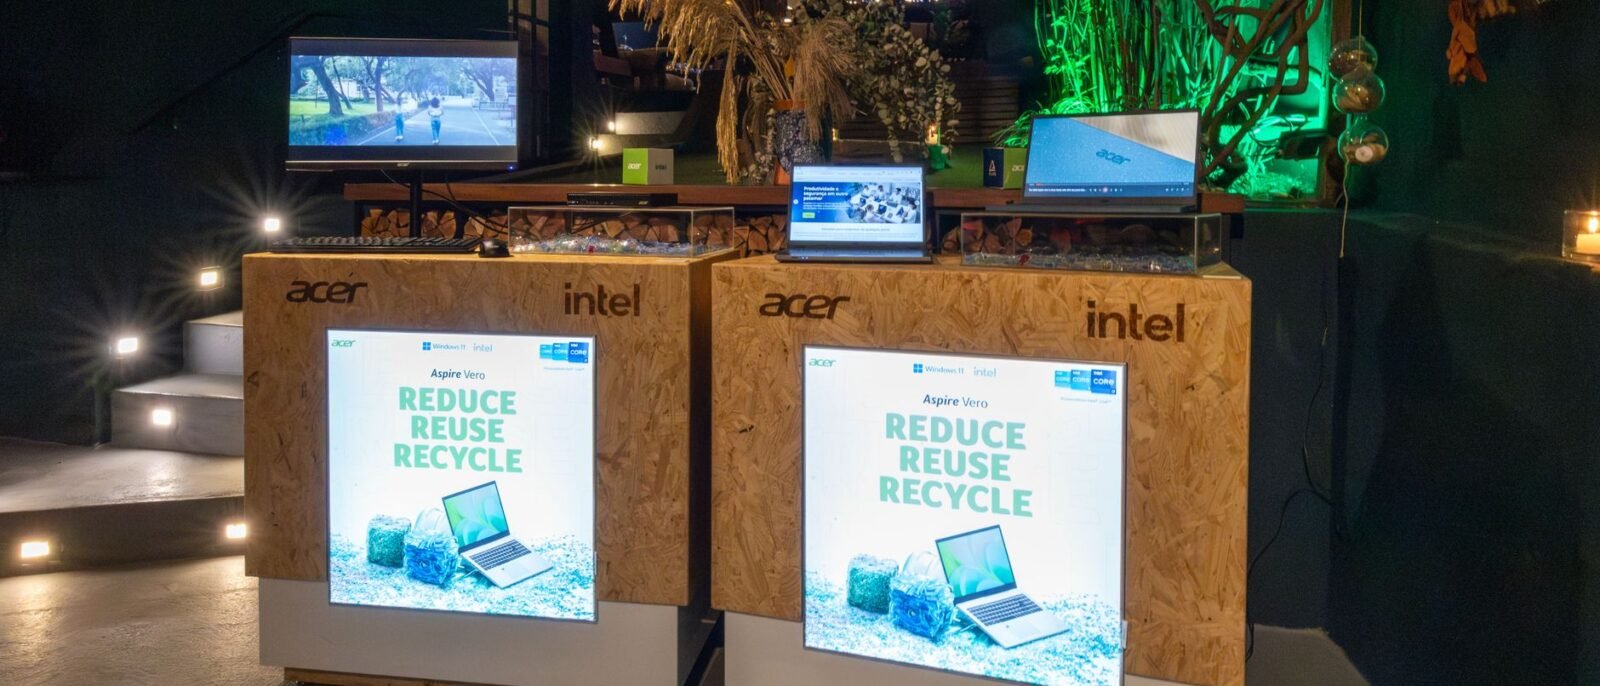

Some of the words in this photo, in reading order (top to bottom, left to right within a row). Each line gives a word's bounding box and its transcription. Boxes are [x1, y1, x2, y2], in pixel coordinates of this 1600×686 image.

[1095, 149, 1131, 165] acer
[286, 281, 368, 303] acer
[564, 282, 640, 317] intel
[759, 293, 851, 320] acer
[1087, 300, 1185, 343] intel
[331, 339, 356, 348] acer
[433, 343, 460, 351] Windows
[473, 343, 494, 352] intel
[430, 368, 462, 380] Aspire
[463, 369, 486, 380] Vero
[808, 358, 837, 368] acer
[925, 366, 957, 375] Windows
[973, 366, 997, 378] intel
[399, 386, 517, 415] REDUCE
[922, 394, 960, 408] Aspire
[961, 397, 989, 409] Vero
[411, 415, 505, 443] REUSE
[885, 412, 1027, 451] REDUCE
[394, 443, 523, 473] RECYCLE
[899, 445, 1012, 482] REUSE
[879, 475, 1033, 518] RECYCLE
